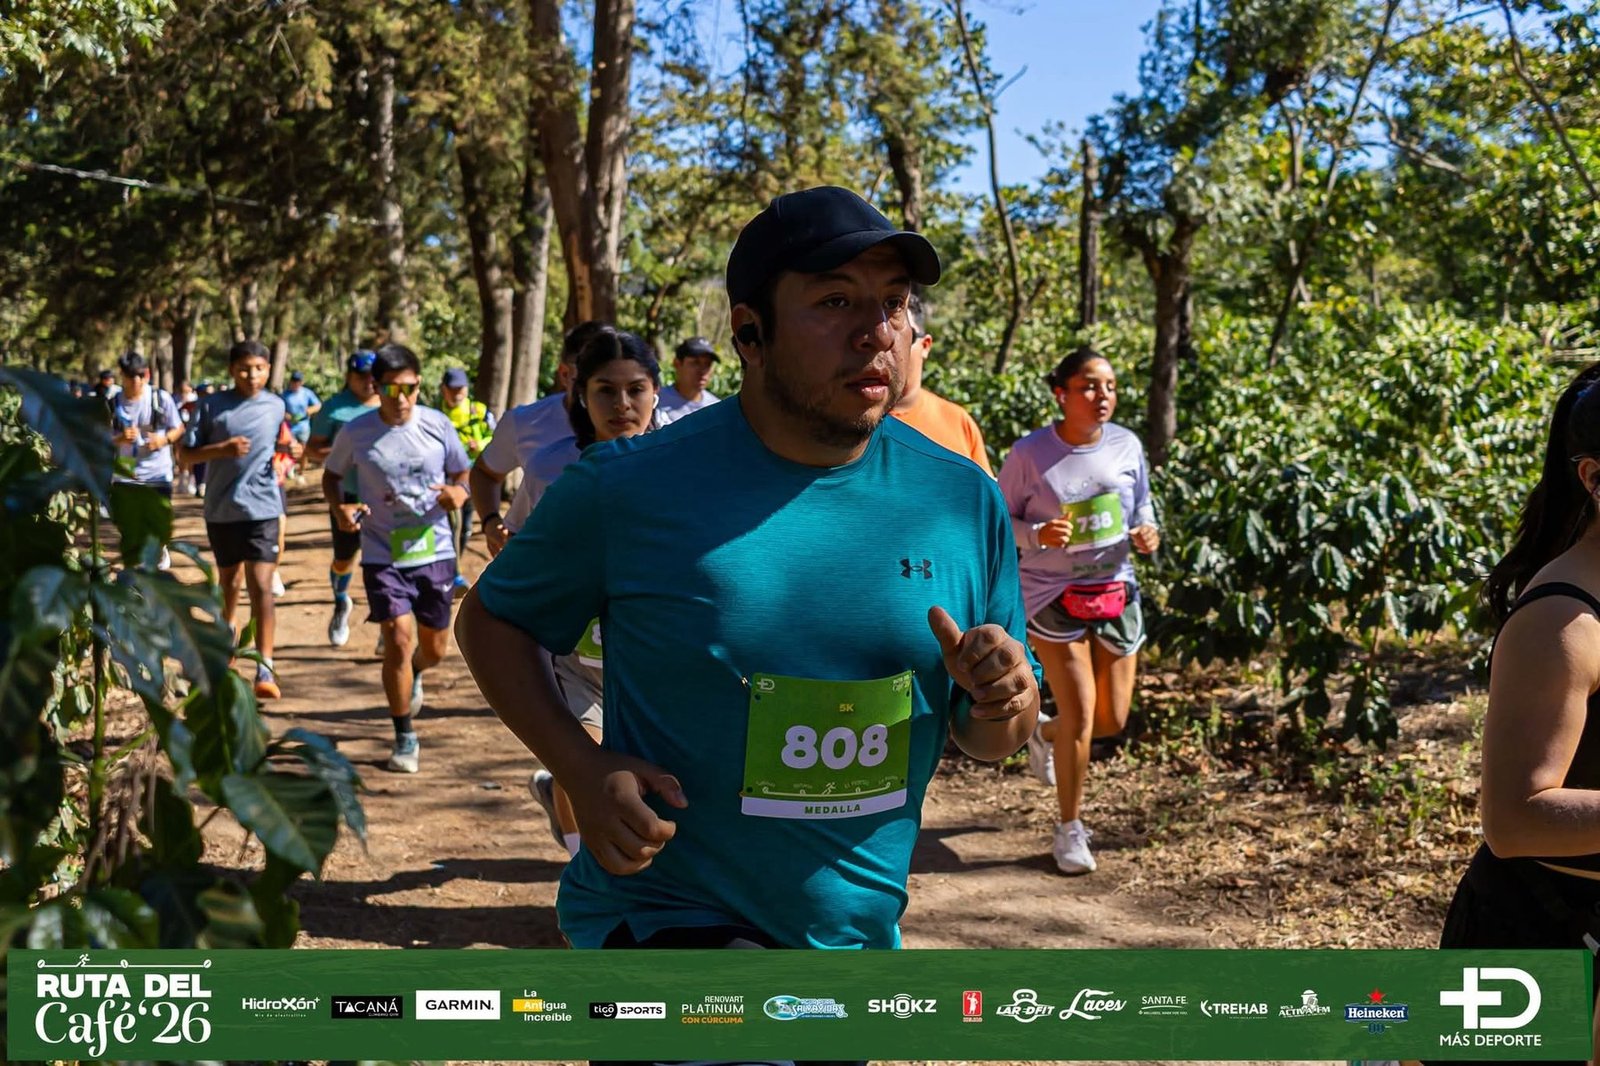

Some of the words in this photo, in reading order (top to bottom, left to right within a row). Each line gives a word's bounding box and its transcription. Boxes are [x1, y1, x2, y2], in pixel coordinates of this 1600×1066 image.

[1076, 511, 1114, 534] 738
[839, 703, 855, 713] 5K
[781, 723, 889, 770] 808
[804, 804, 861, 815] MEDALLA
